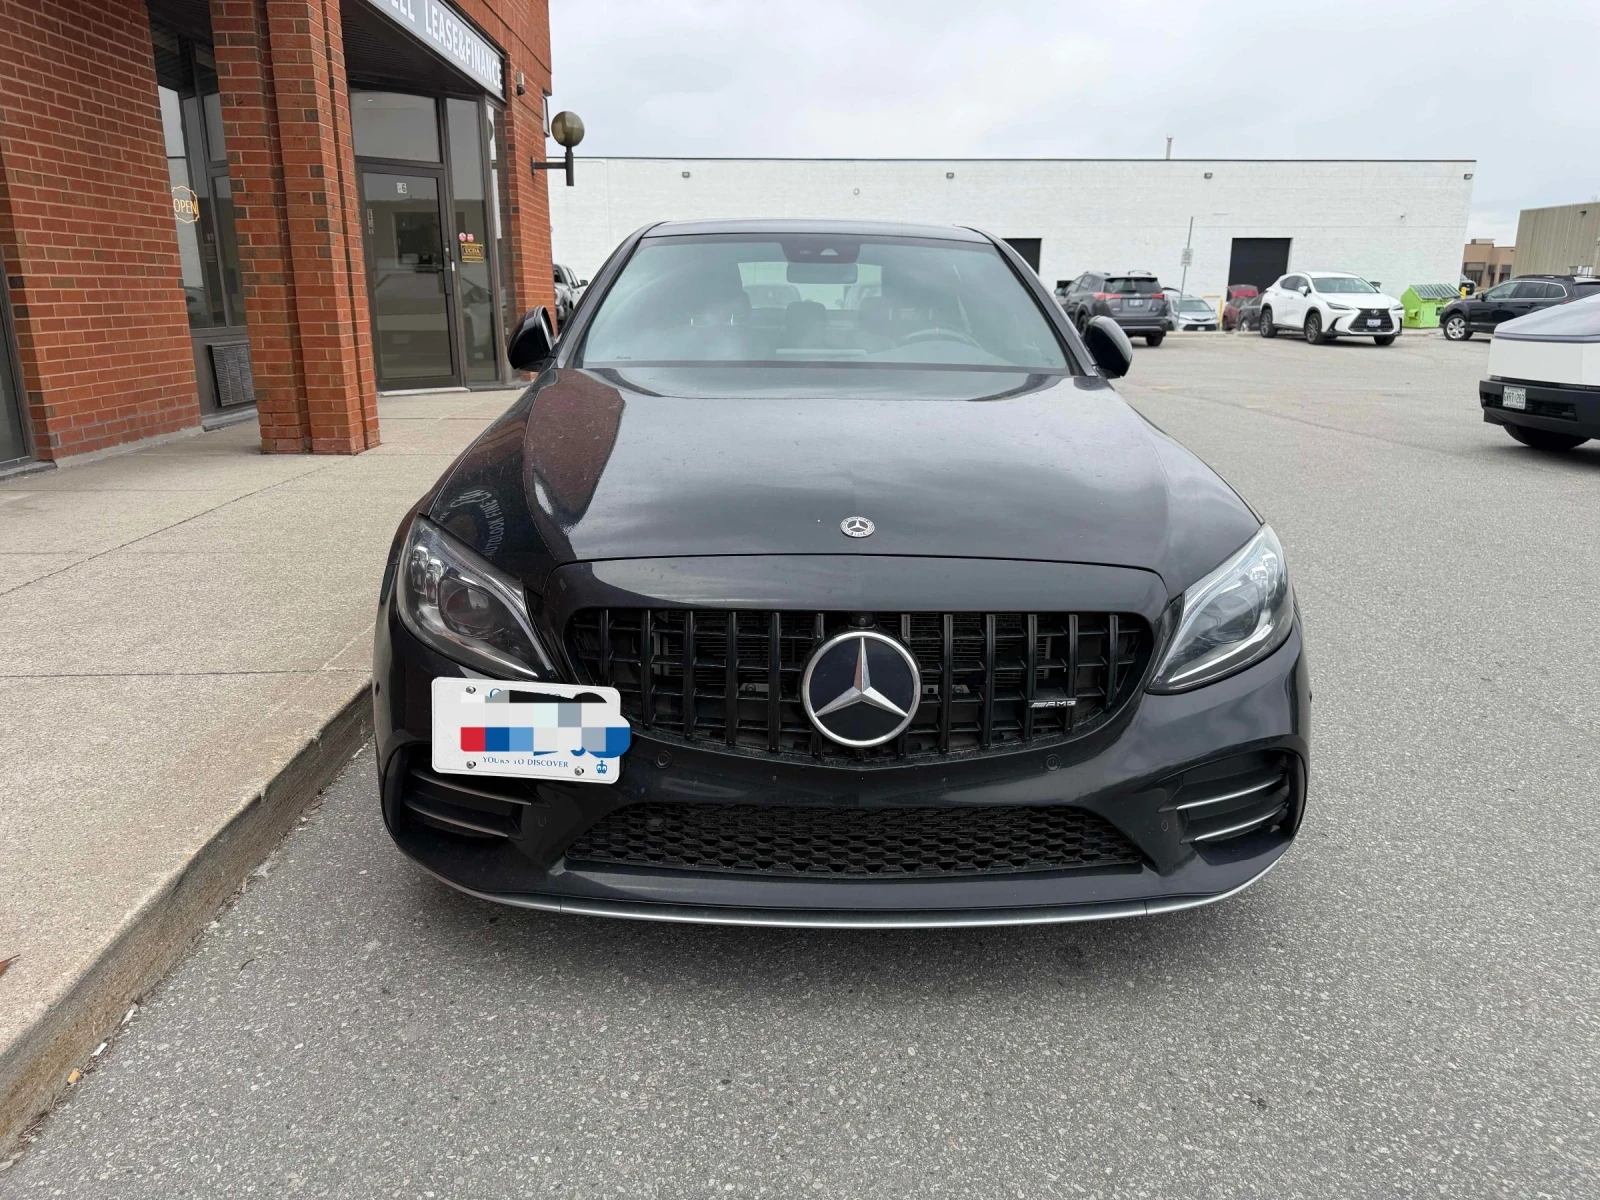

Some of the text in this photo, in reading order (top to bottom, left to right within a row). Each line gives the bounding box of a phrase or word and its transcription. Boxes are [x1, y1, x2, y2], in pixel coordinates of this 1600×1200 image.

[425, 0, 503, 91] LEASE&FINANCE
[173, 198, 198, 215] OPEN
[527, 759, 569, 768] DISCOVER
